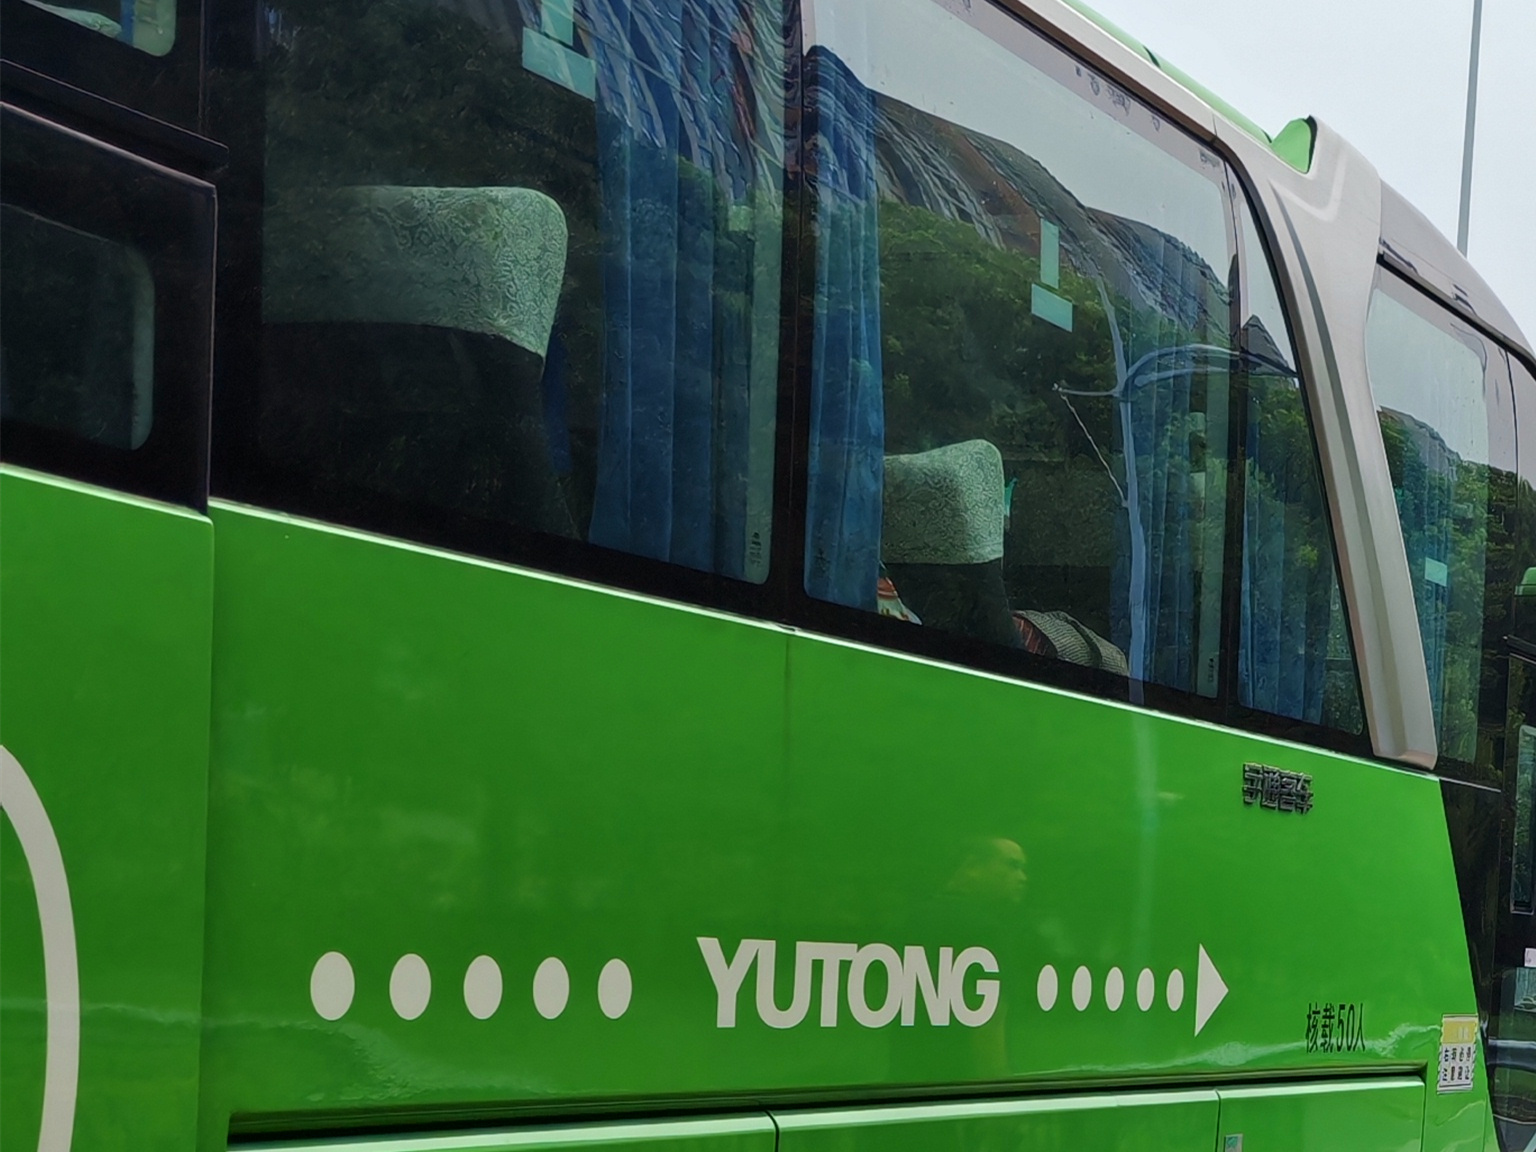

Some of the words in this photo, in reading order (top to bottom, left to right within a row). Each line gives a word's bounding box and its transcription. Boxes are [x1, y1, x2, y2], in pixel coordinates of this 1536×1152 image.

[1243, 763, 1314, 815] 宇通客车
[696, 936, 1000, 1029] YUTONG
[1305, 1002, 1366, 1053] 核载50人
